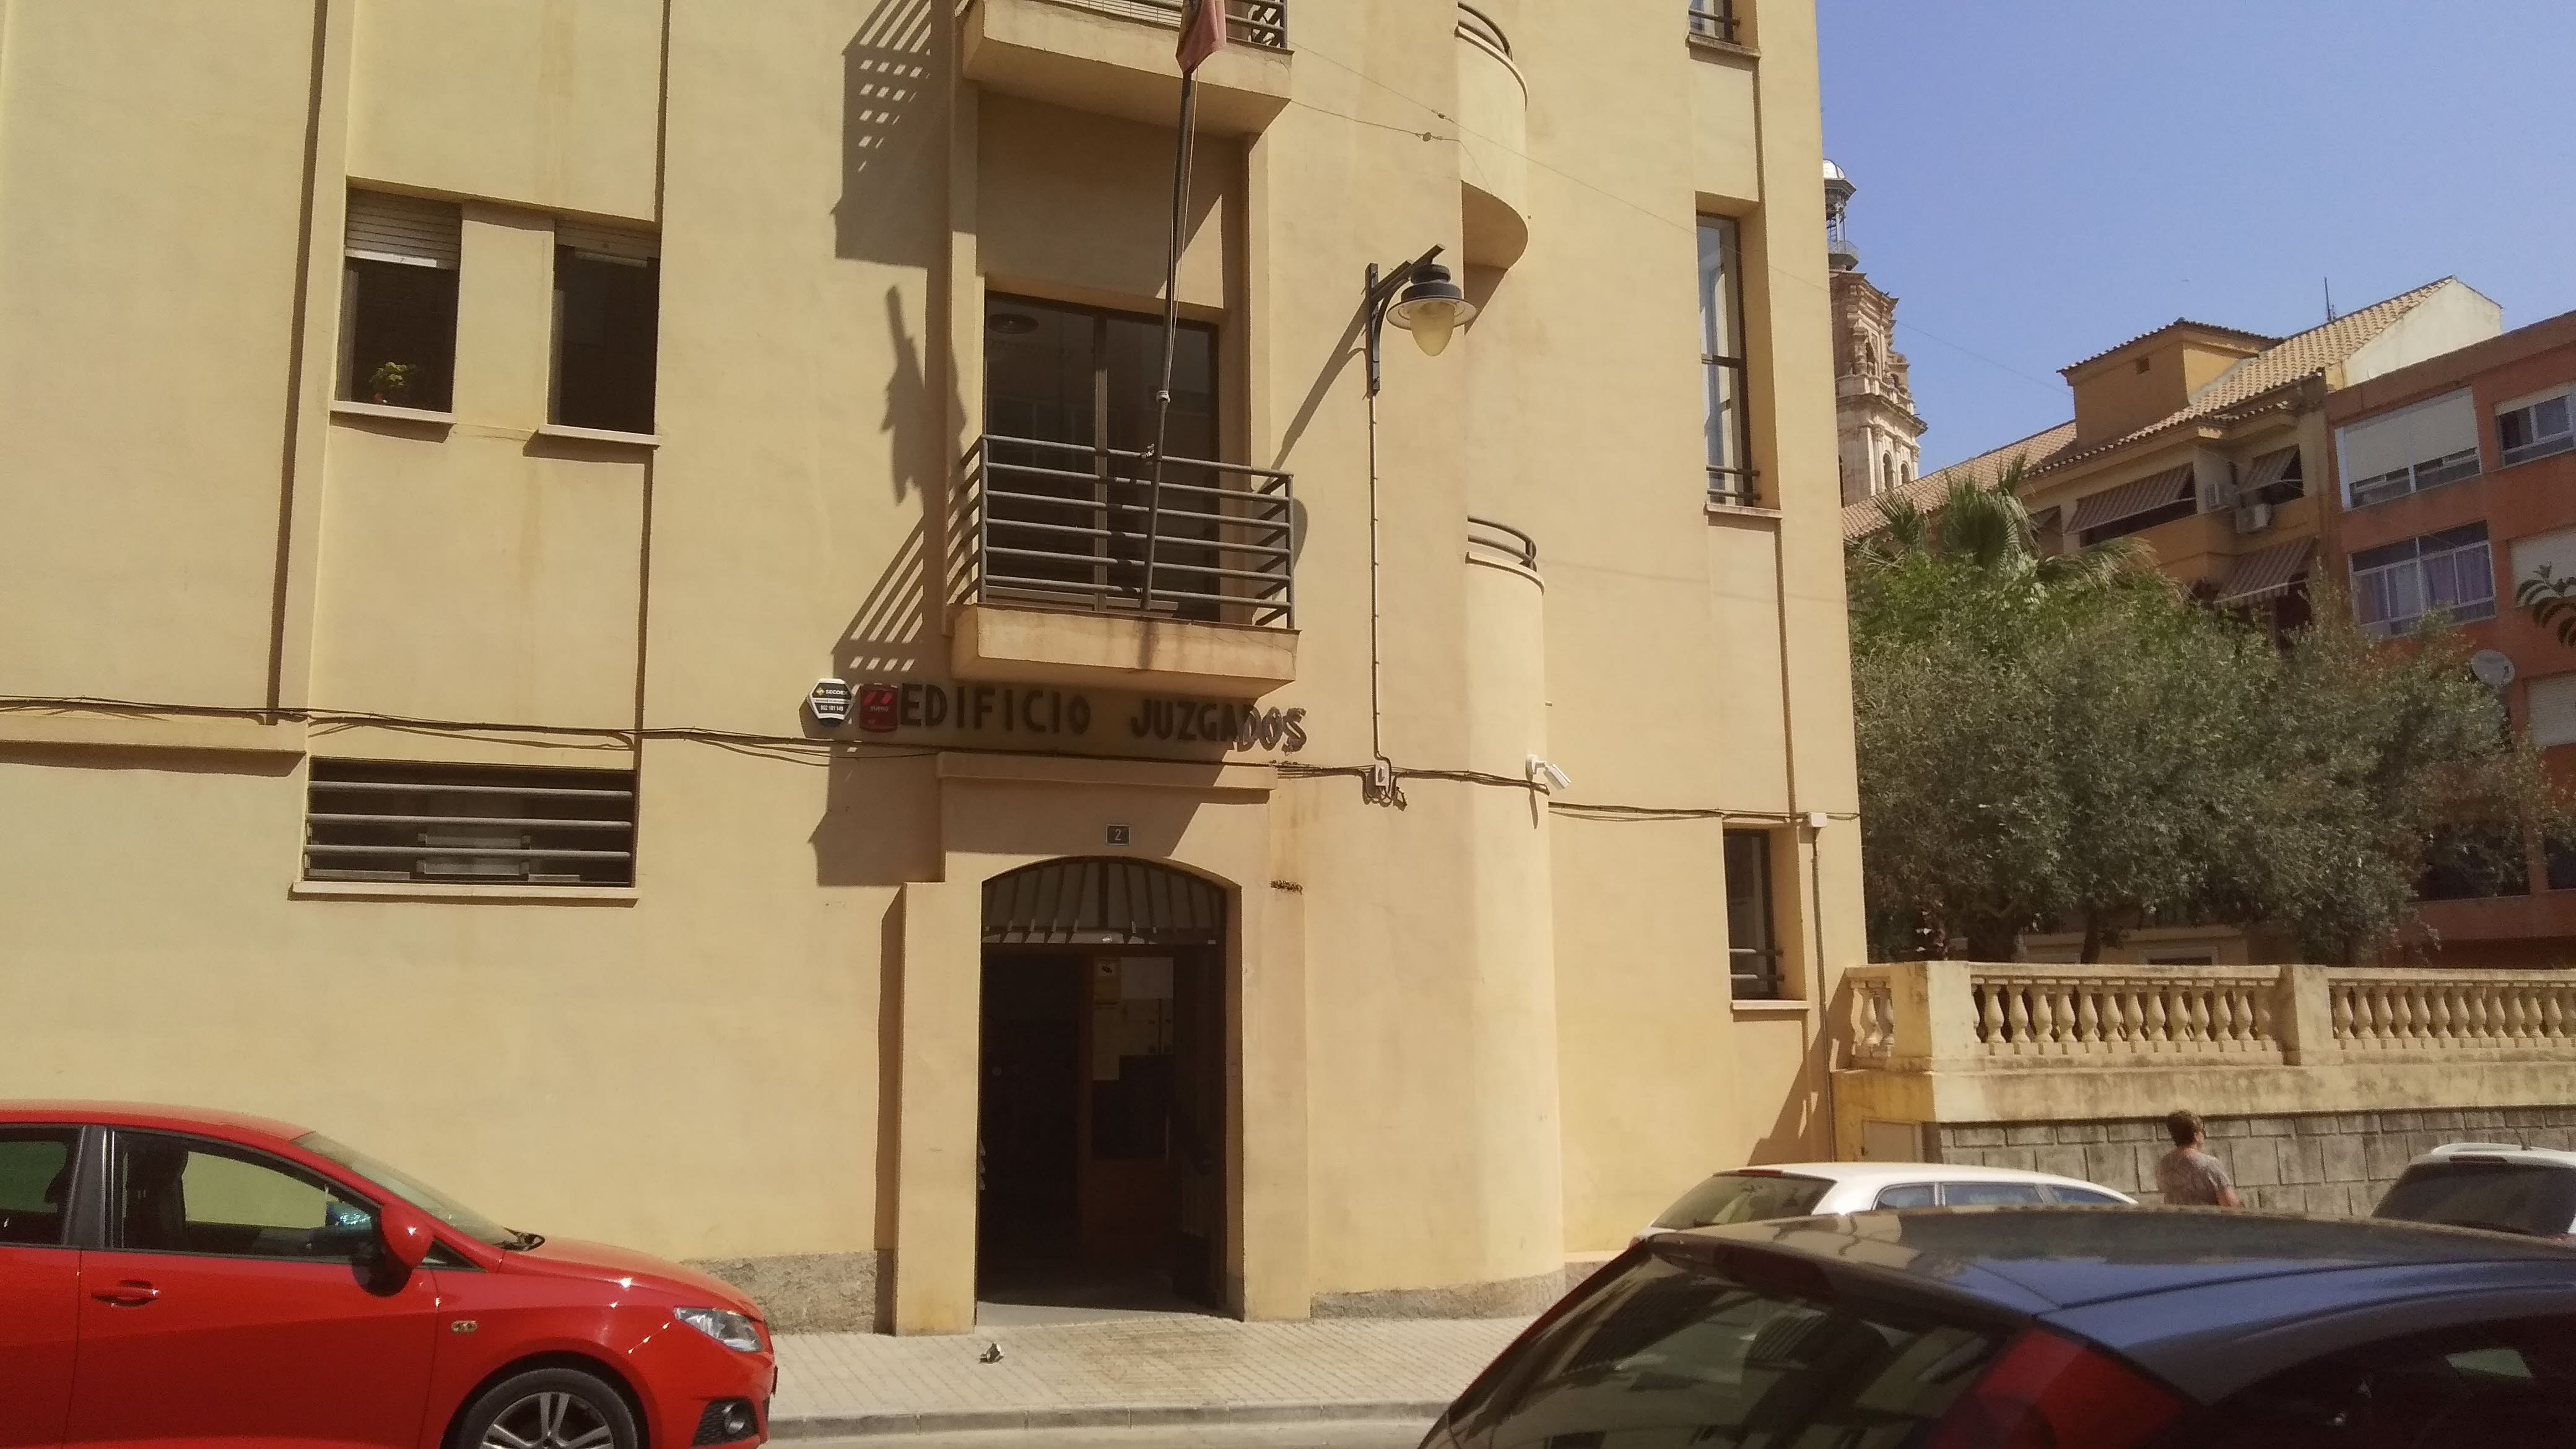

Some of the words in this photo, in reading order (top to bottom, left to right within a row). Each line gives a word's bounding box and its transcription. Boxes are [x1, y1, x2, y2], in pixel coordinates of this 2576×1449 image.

[900, 683, 1091, 735] EDIFICIO
[1131, 699, 1307, 753] JUZGADOS
[1115, 829, 1121, 841] 2
